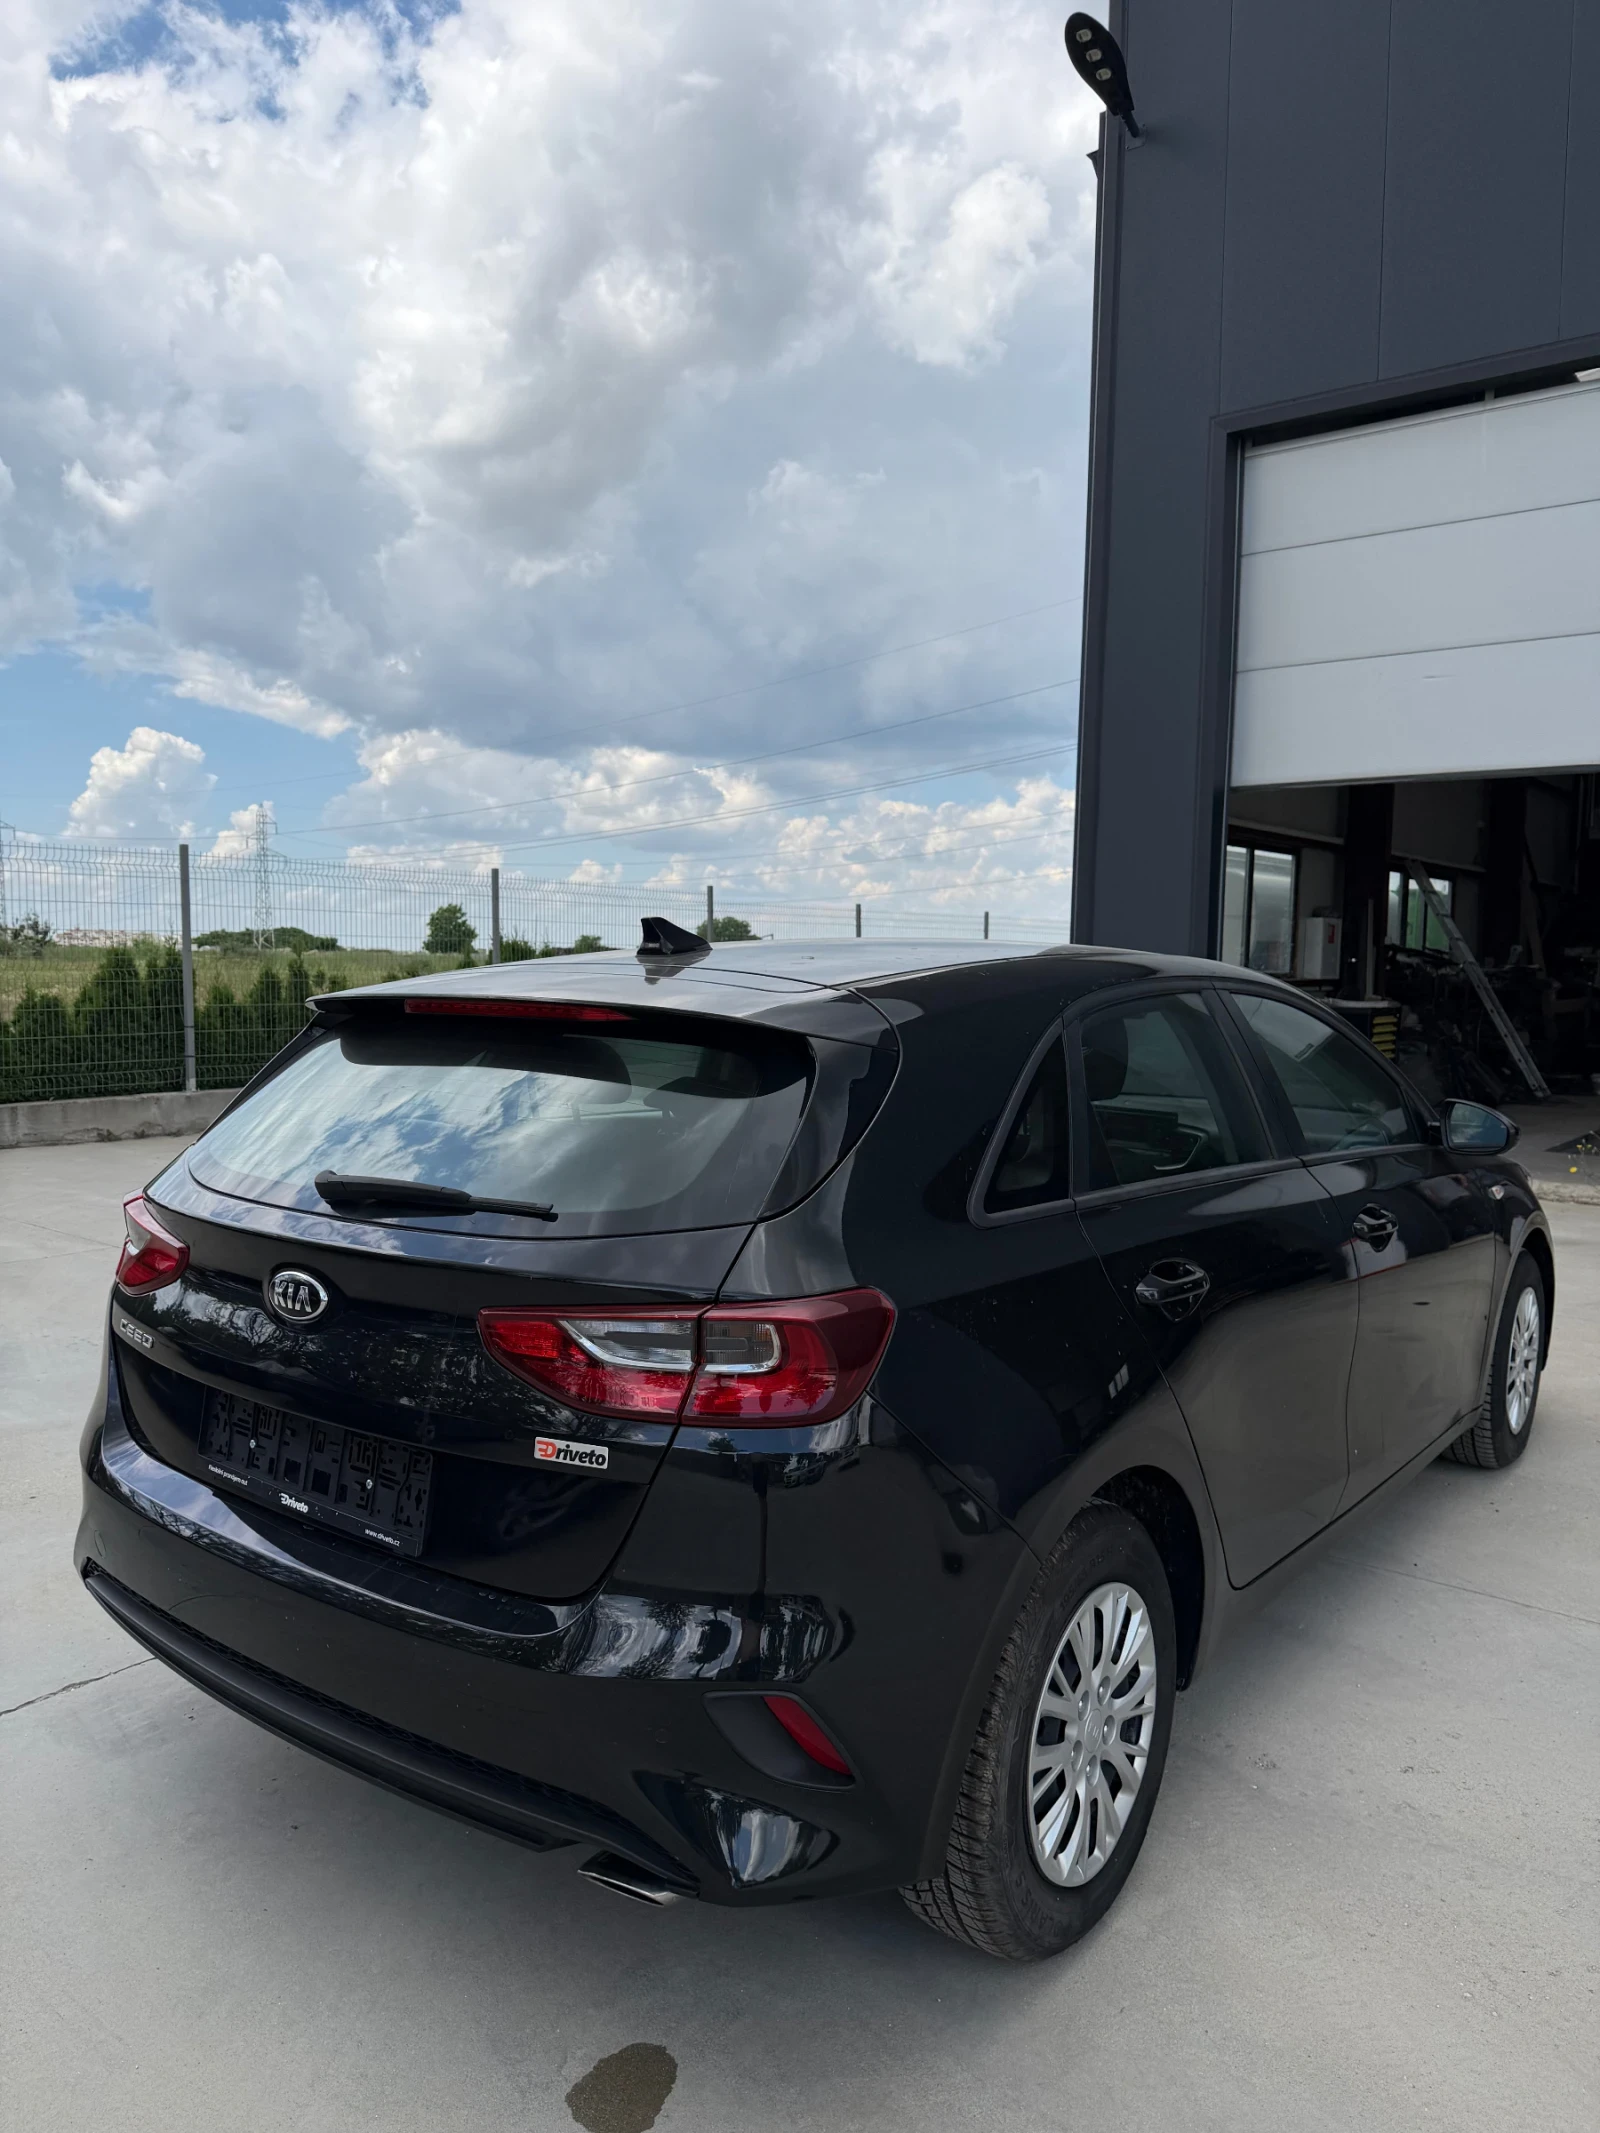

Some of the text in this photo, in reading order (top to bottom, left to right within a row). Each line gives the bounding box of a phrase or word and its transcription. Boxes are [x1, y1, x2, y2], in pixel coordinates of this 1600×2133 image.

[273, 1280, 312, 1313] KIA
[120, 1318, 154, 1349] CEED
[535, 1440, 607, 1466] Driveto
[279, 1492, 309, 1513] Driveto
